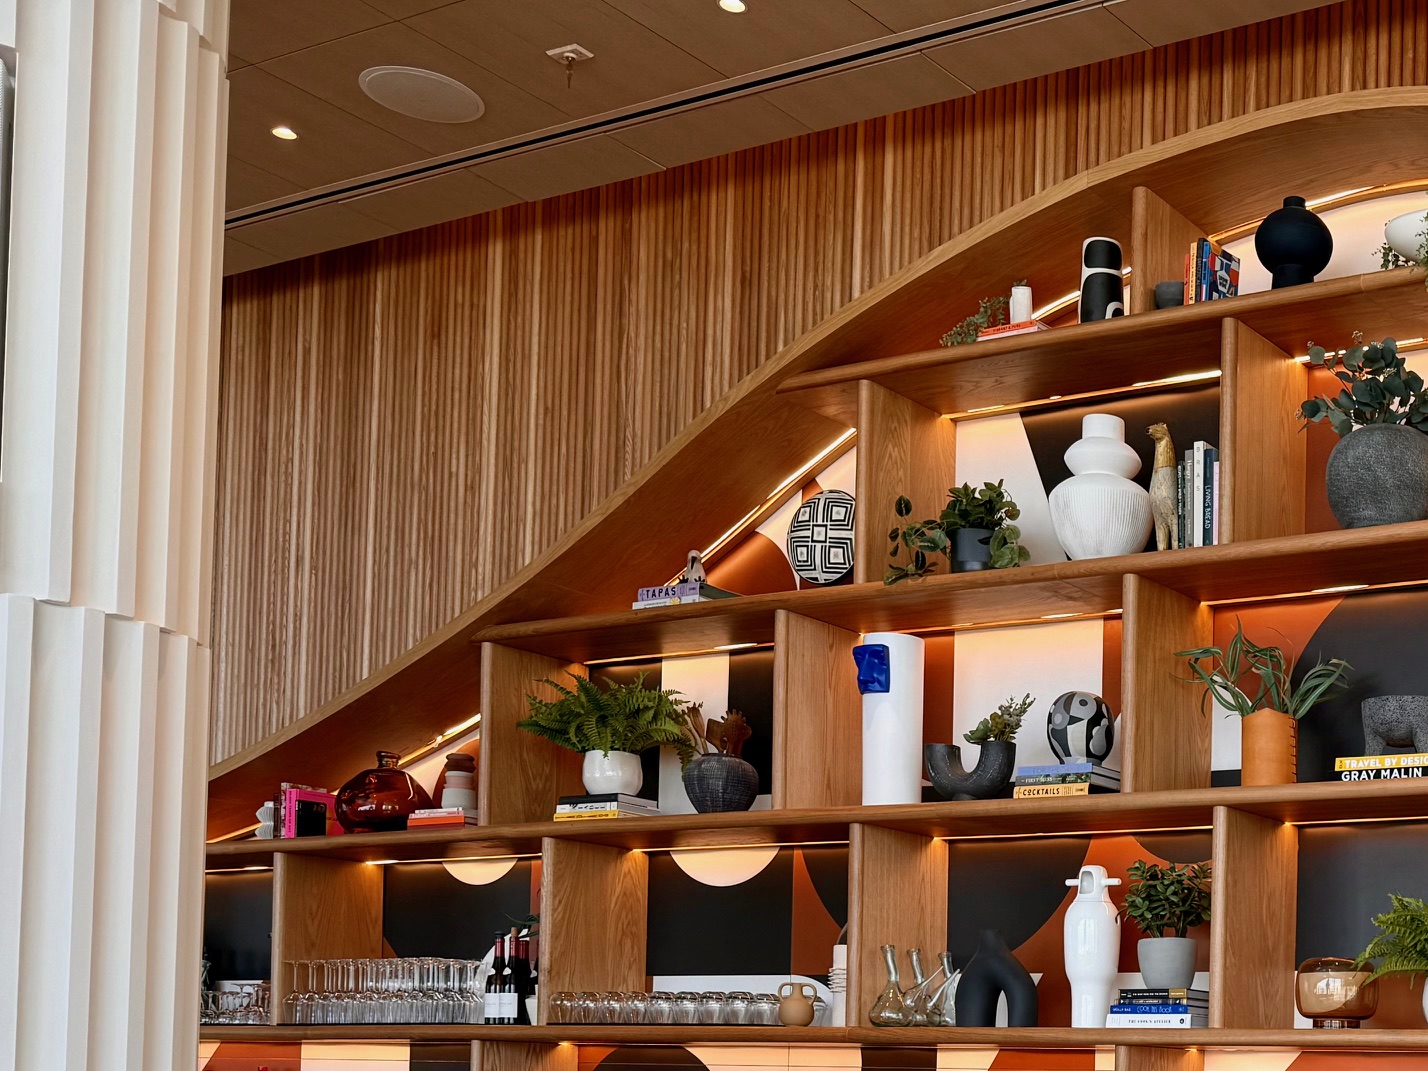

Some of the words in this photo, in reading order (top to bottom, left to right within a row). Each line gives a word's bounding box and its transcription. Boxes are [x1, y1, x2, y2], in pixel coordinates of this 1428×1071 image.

[1204, 485, 1212, 507] LIVING
[645, 586, 677, 599] TAPAS
[1344, 757, 1382, 769] TRAVEL
[1384, 757, 1397, 767] BY
[1341, 769, 1377, 782] GRAY
[1380, 767, 1423, 779] MALIN
[1022, 787, 1060, 796] COCKTAILS
